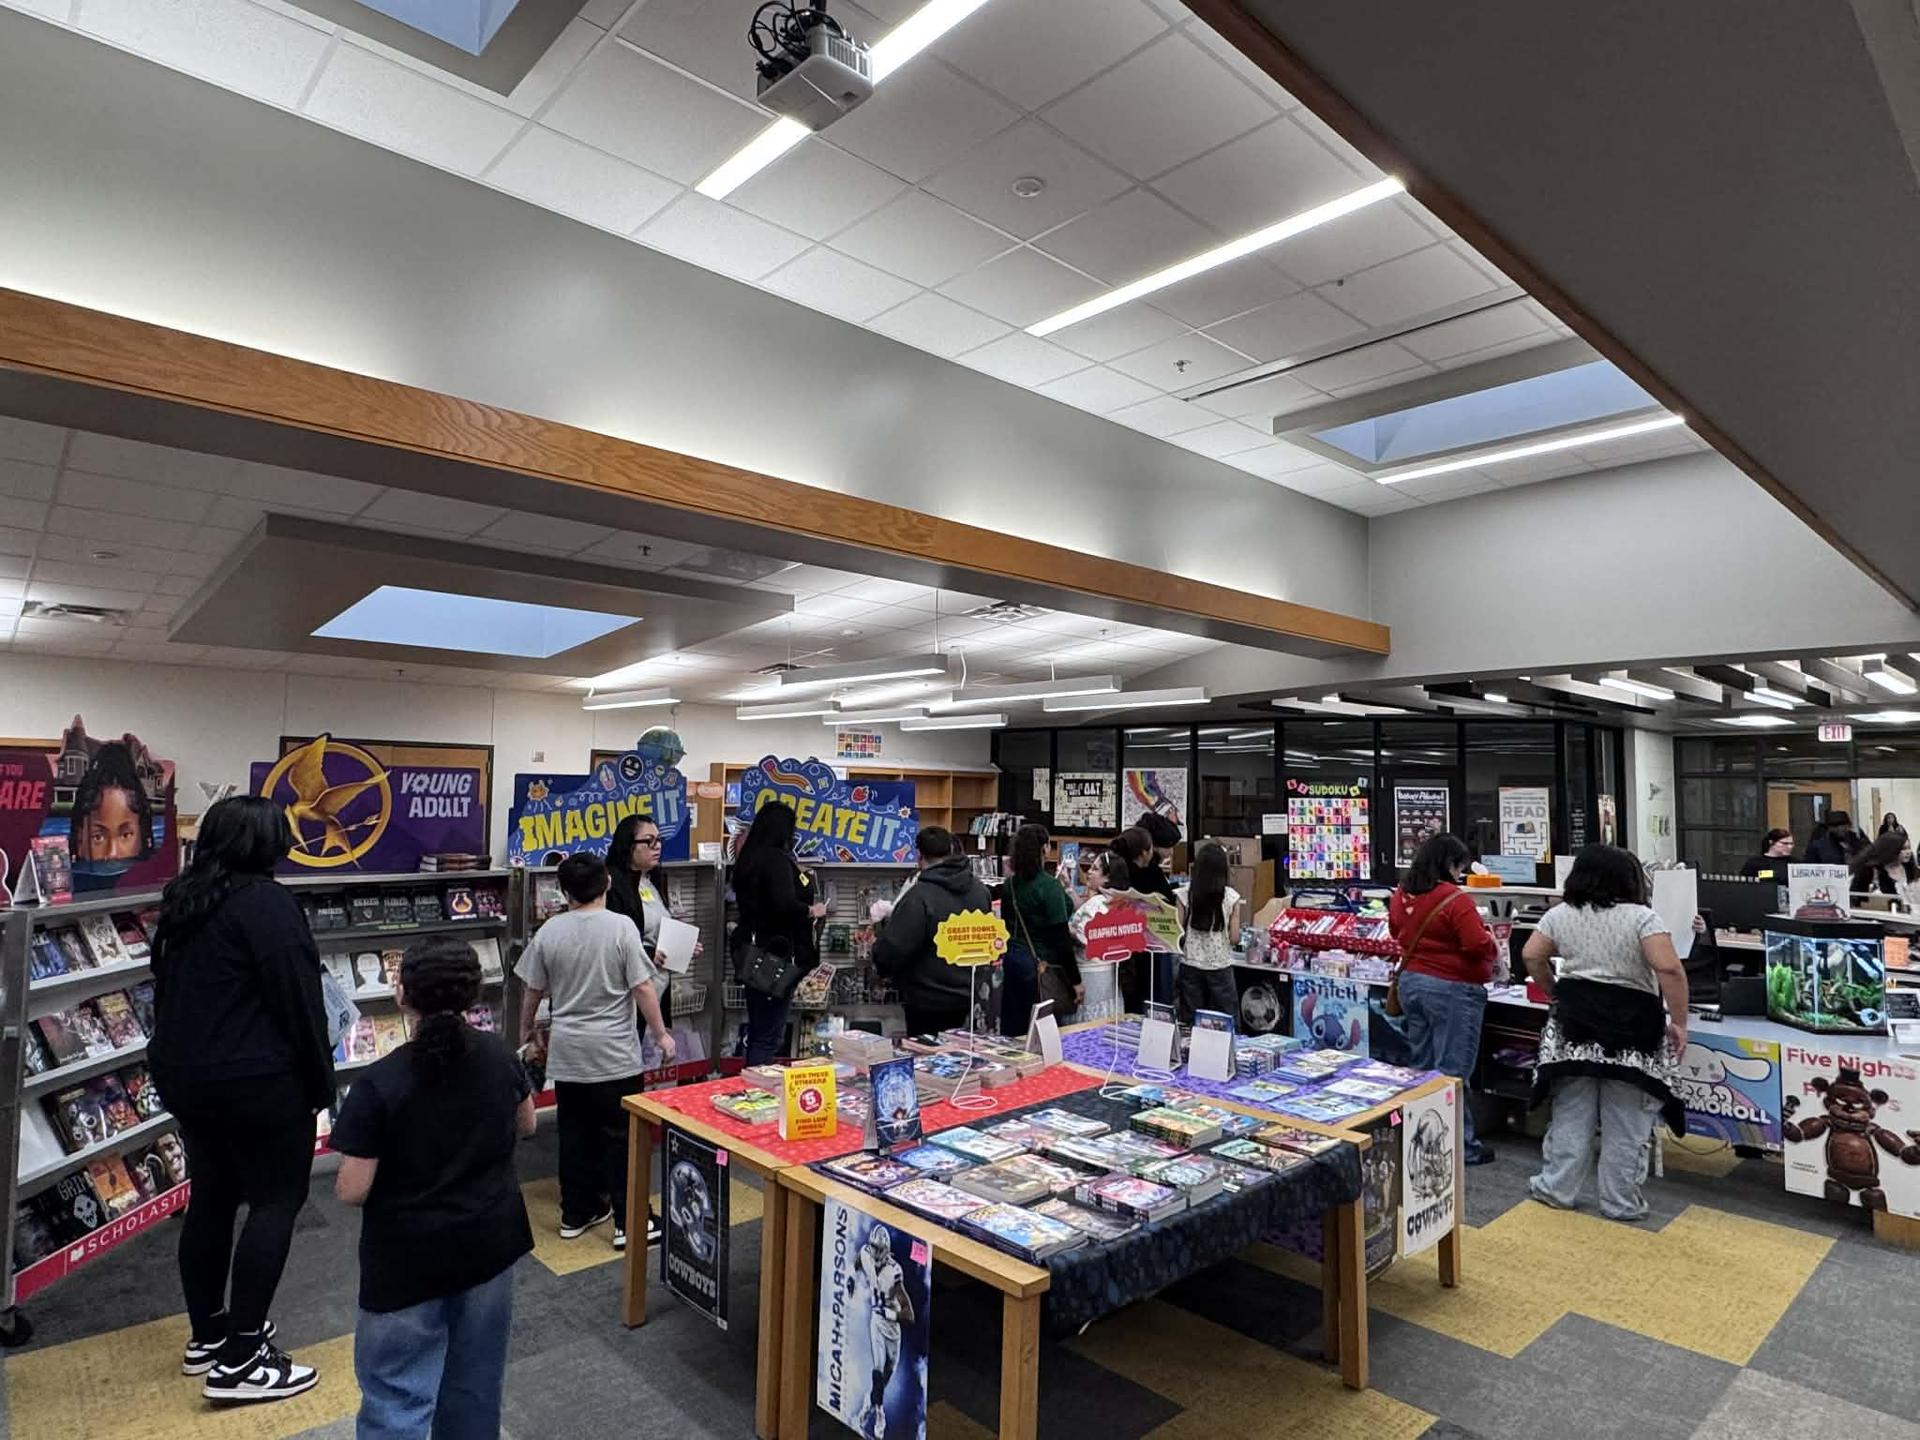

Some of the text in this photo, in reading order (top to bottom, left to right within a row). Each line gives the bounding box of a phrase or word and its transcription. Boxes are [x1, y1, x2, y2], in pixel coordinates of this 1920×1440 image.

[1825, 726, 1846, 740] EXIT
[400, 772, 473, 795] YOUNG
[1308, 784, 1348, 796] SUDOKU
[408, 796, 472, 818] ADULT
[656, 789, 680, 825] IT
[1503, 805, 1546, 818] READ
[869, 816, 901, 851] IT
[1791, 868, 1826, 879] LIBRARY
[1088, 925, 1118, 940] GRAPHIC
[1118, 922, 1144, 936] NOVELS
[1786, 1047, 1832, 1067] Five
[1685, 1096, 1772, 1124] MOROLL
[832, 1206, 848, 1319] PARSONS
[669, 1252, 716, 1299] COWBOYS
[829, 1329, 843, 1413] MICAH
